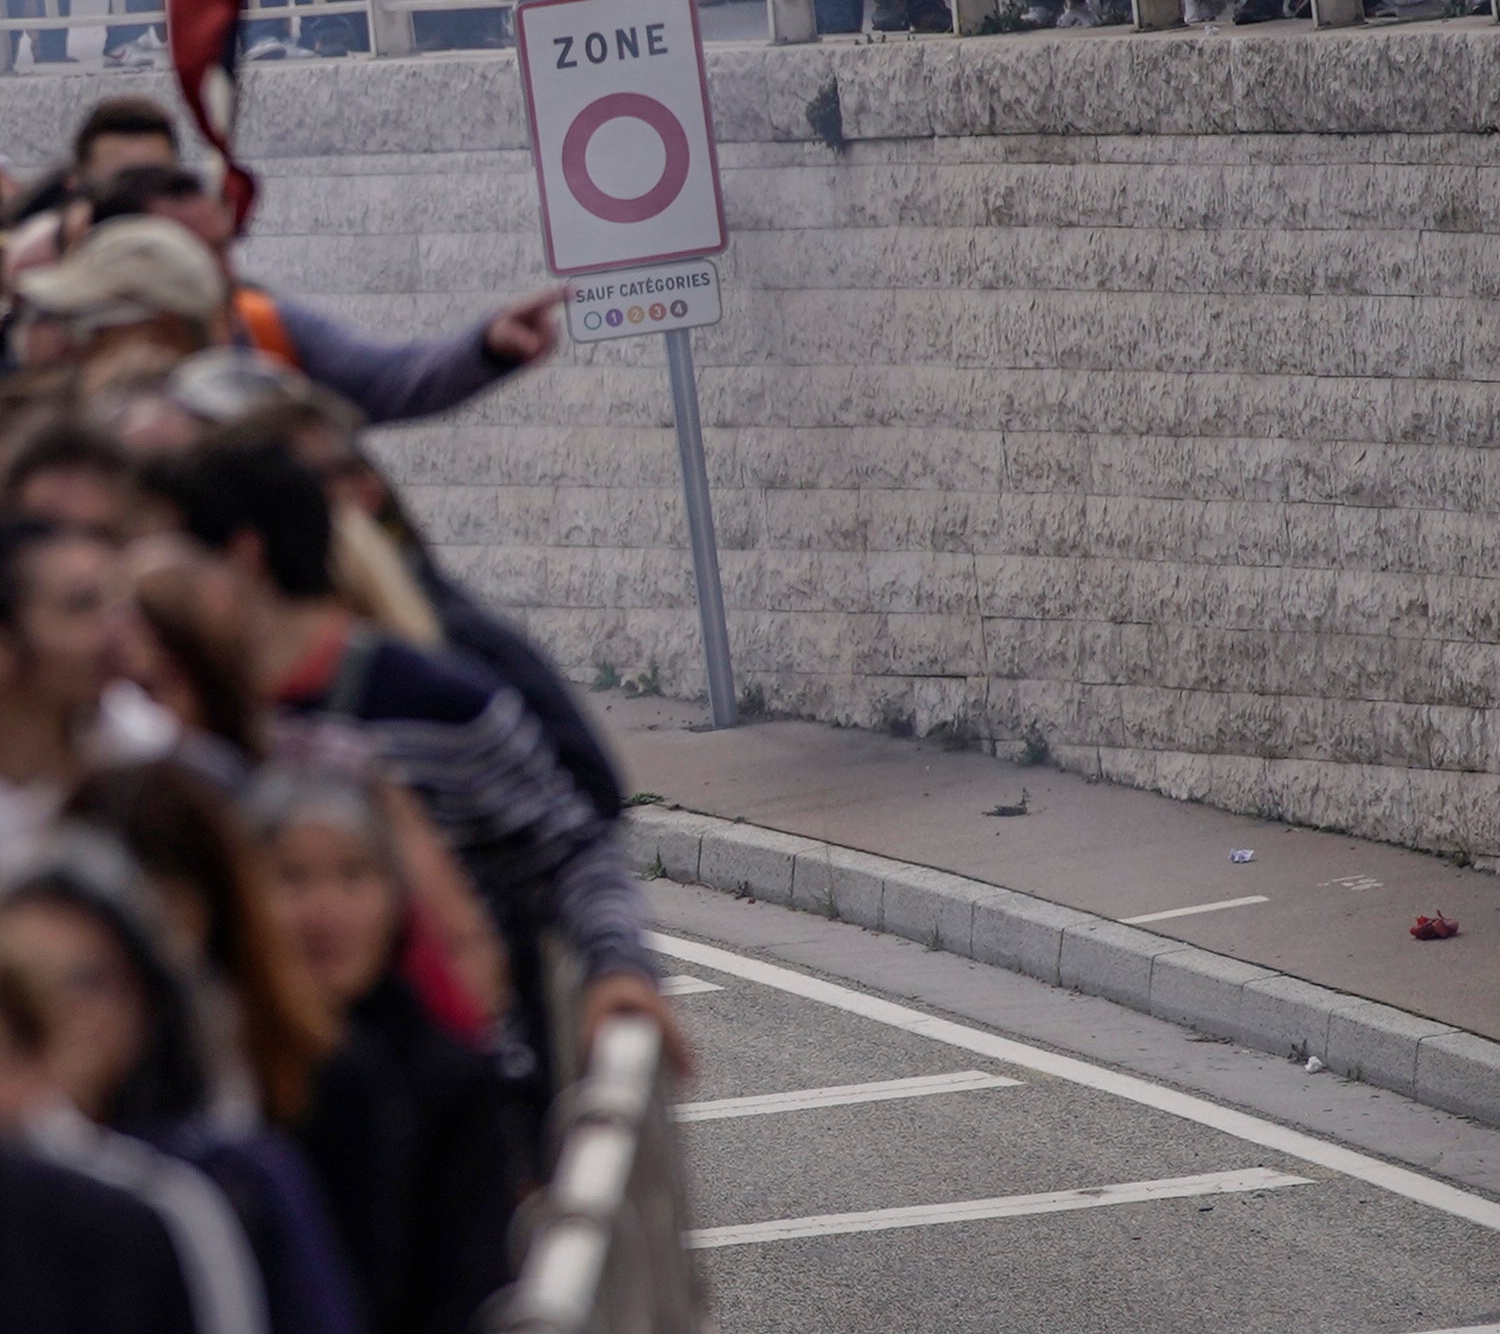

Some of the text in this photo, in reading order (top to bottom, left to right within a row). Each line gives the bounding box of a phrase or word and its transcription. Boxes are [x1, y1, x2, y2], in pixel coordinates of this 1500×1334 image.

[553, 22, 669, 70] ZONE
[575, 271, 711, 304] SAUF CATÉGORIES
